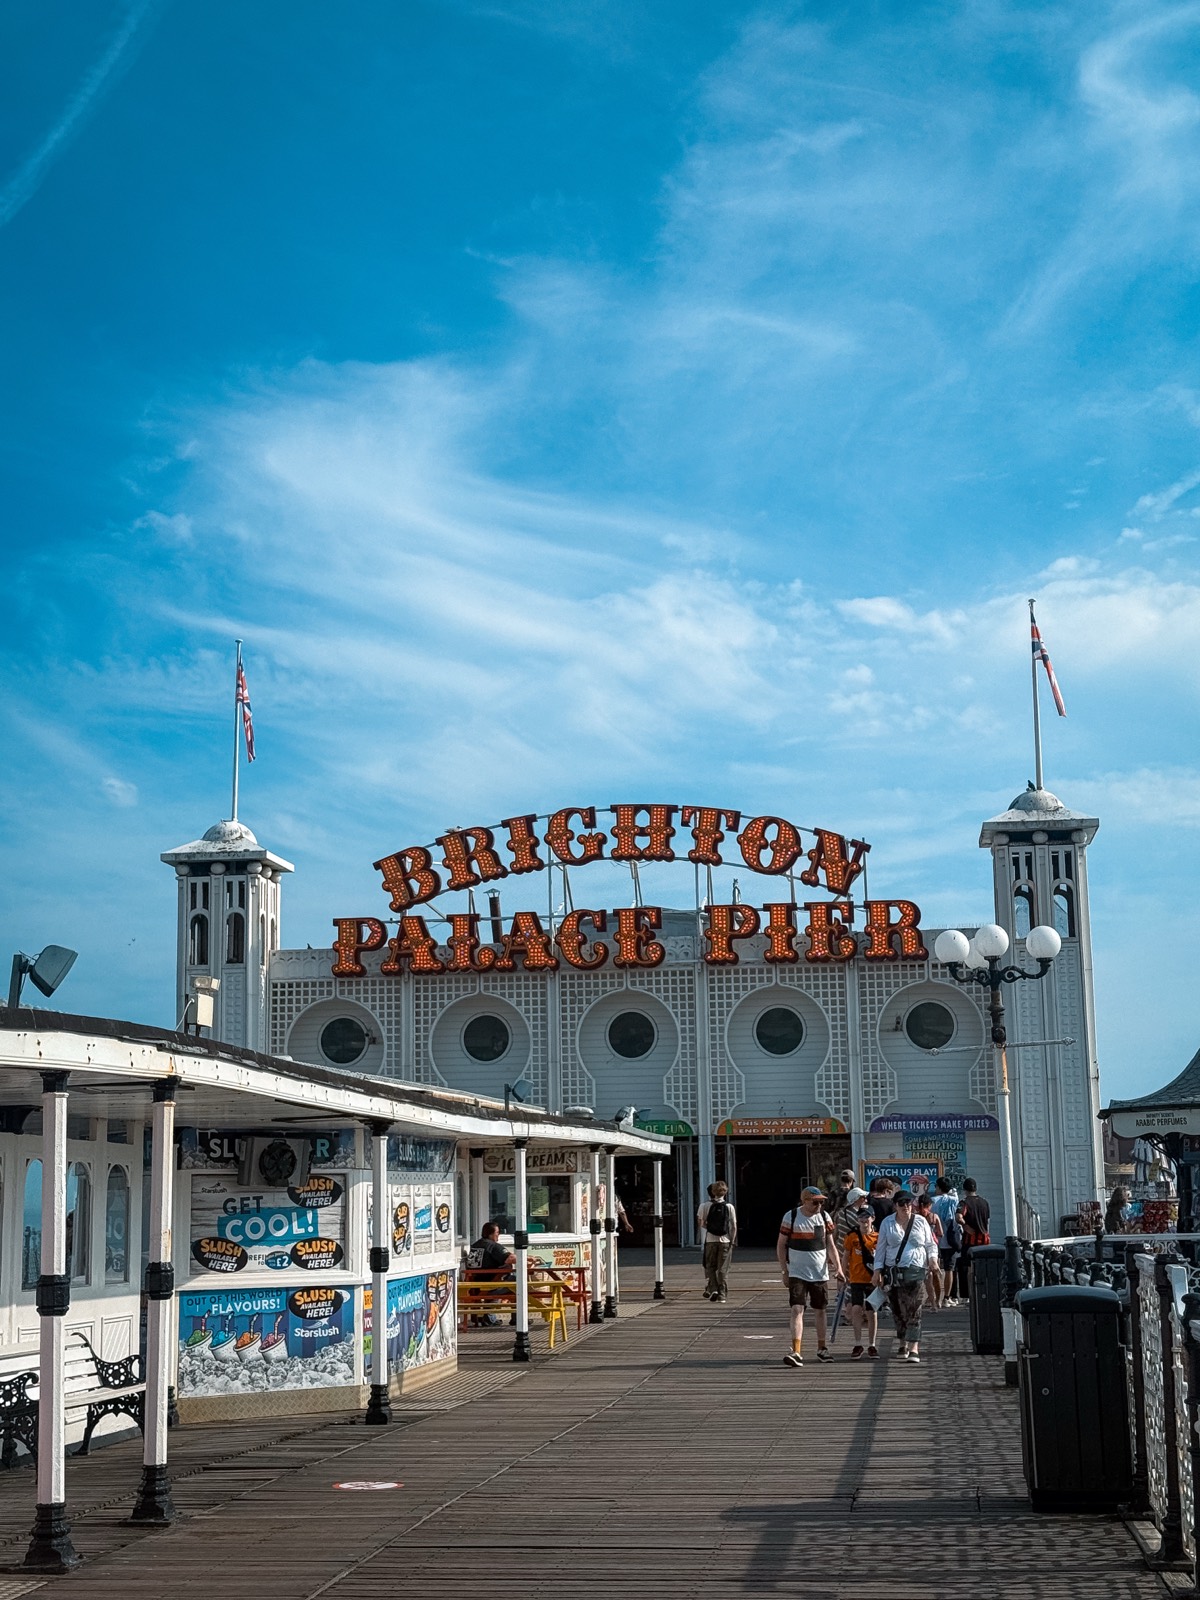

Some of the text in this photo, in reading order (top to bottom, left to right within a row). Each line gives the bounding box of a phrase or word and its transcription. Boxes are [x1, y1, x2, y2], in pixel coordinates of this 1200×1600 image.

[373, 803, 872, 912] BRIGHTON
[332, 899, 928, 977] PALACE PIER
[881, 1118, 990, 1130] WHERE TICKETS MAKE PRIZES
[1135, 1117, 1188, 1127] ARABIC PERFUMES
[645, 1125, 659, 1133] OF
[664, 1124, 687, 1134] FUN
[906, 1140, 963, 1151] REDEMPTION
[526, 1152, 566, 1168] CREAM
[866, 1168, 899, 1177] WATCH
[900, 1168, 912, 1176] US
[913, 1167, 937, 1176] PLAY!
[299, 1190, 331, 1199] AVAILABLE
[222, 1195, 264, 1216] GET
[305, 1197, 333, 1206] HERE!
[225, 1210, 314, 1243] COOL!
[200, 1239, 243, 1258] SLUSH
[296, 1240, 337, 1255] SLUSH
[203, 1253, 238, 1263] AVAILABLE
[276, 1257, 289, 1267] £2
[301, 1252, 333, 1260] AVAILABLE
[208, 1260, 238, 1272] HERE!
[307, 1258, 335, 1269] HERE!
[186, 1289, 283, 1307] OUT OF THIS WORLD
[294, 1289, 336, 1306] SLUSH
[211, 1298, 281, 1315] FLAVOURS!
[300, 1300, 333, 1310] AVAILABLE
[306, 1307, 334, 1318] HERE!
[294, 1325, 340, 1338] Starslush
